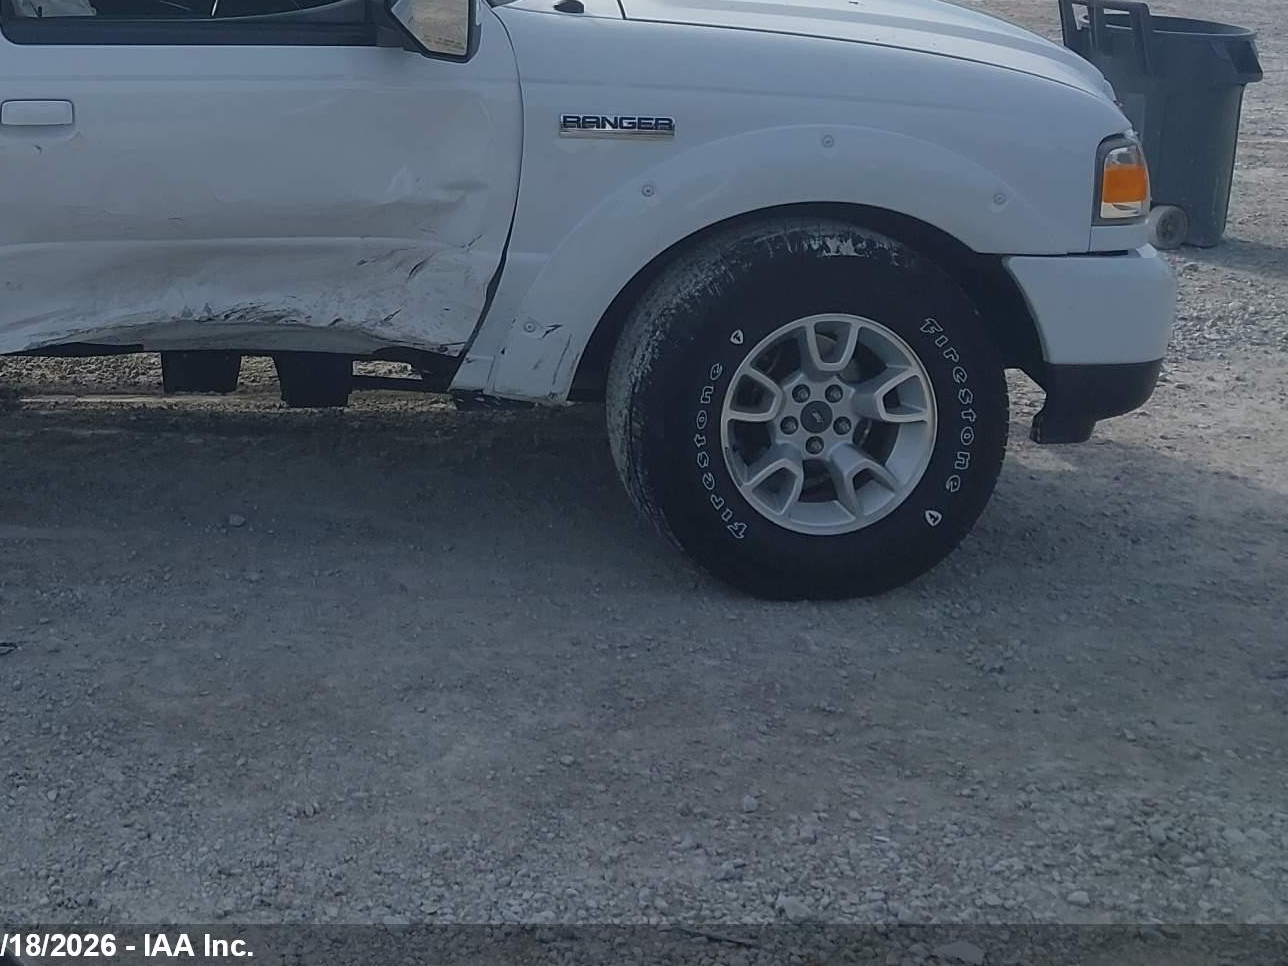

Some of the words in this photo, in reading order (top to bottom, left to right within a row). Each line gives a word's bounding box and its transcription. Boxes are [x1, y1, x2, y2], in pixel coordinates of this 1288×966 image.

[561, 115, 675, 131] RANGER
[693, 362, 748, 540] Firestone
[919, 317, 977, 493] Firestone
